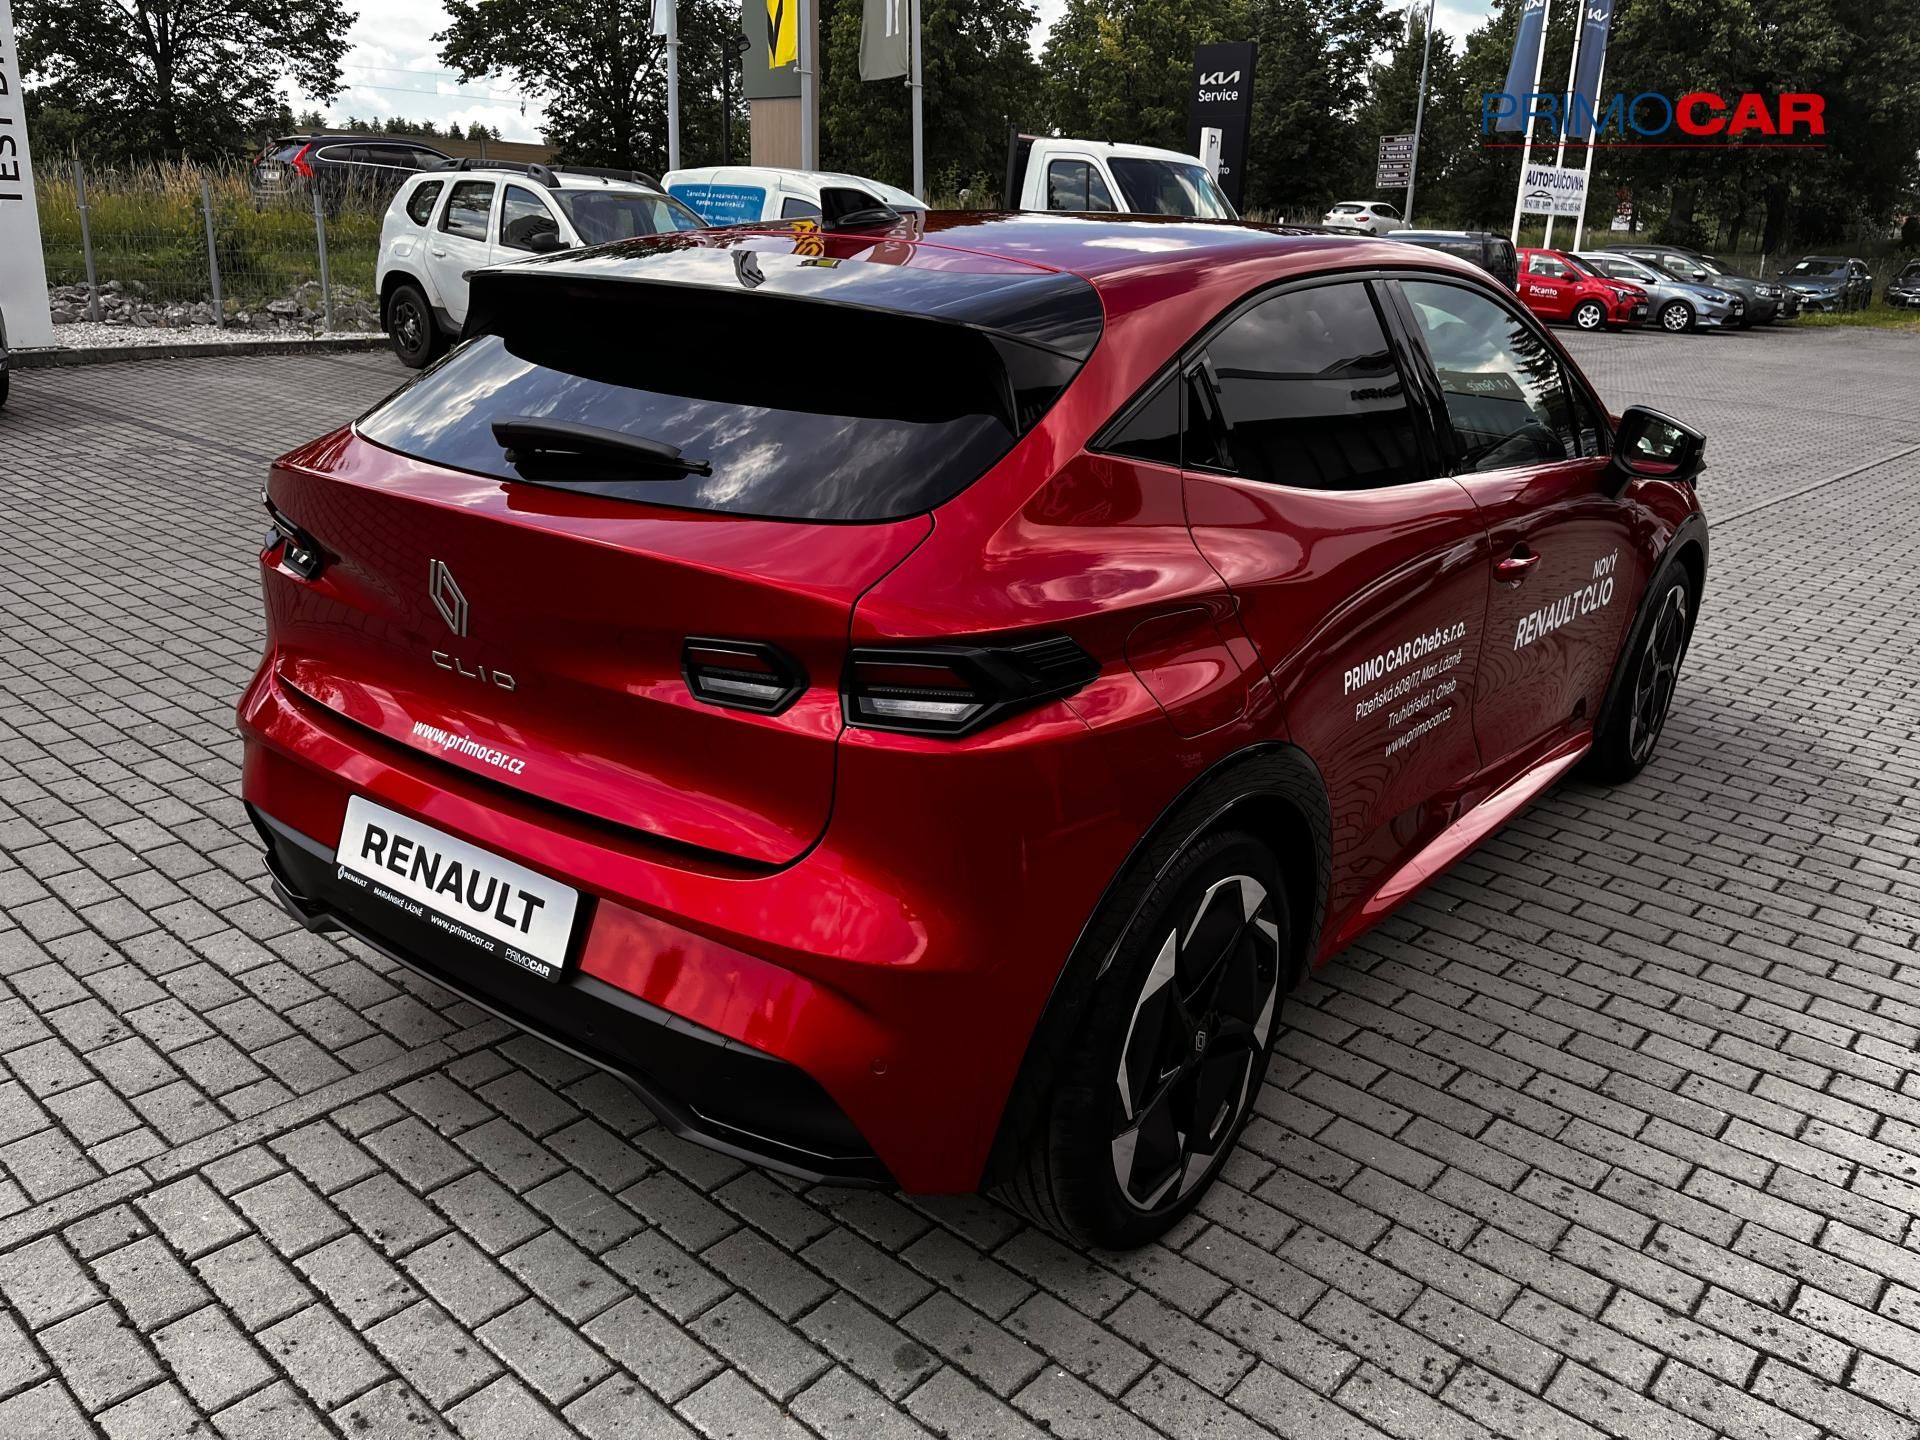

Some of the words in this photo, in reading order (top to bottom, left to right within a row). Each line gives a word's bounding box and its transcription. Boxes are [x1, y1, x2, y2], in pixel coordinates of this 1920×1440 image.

[1198, 88, 1239, 102] Service
[1529, 285, 1558, 296] Picanto
[1592, 547, 1618, 580] NOVÝ
[1513, 589, 1583, 651] RENAULT
[1581, 576, 1614, 615] CLIO
[431, 650, 516, 692] CLIO
[1344, 655, 1384, 695] PRIMO
[1386, 642, 1412, 672] CAR
[1412, 627, 1442, 659] Cheb
[1442, 621, 1466, 645] s.r.o.
[1355, 684, 1394, 721] Plzeňská
[1420, 663, 1438, 682] Mar.
[1438, 649, 1462, 674] Lázně
[1388, 690, 1430, 729] Truhlářská
[1435, 677, 1457, 700] Cheb
[412, 720, 526, 775] www.primocar.cz
[1385, 707, 1452, 757] www.primocar.cz
[360, 822, 545, 934] RENAULT
[343, 871, 368, 888] RENAULT
[373, 887, 405, 908] MARIÁNSKÉ
[404, 902, 424, 917] LÁZNĚ
[431, 914, 495, 952] www.primocar.cz
[505, 947, 551, 977] PRIMOCAR
